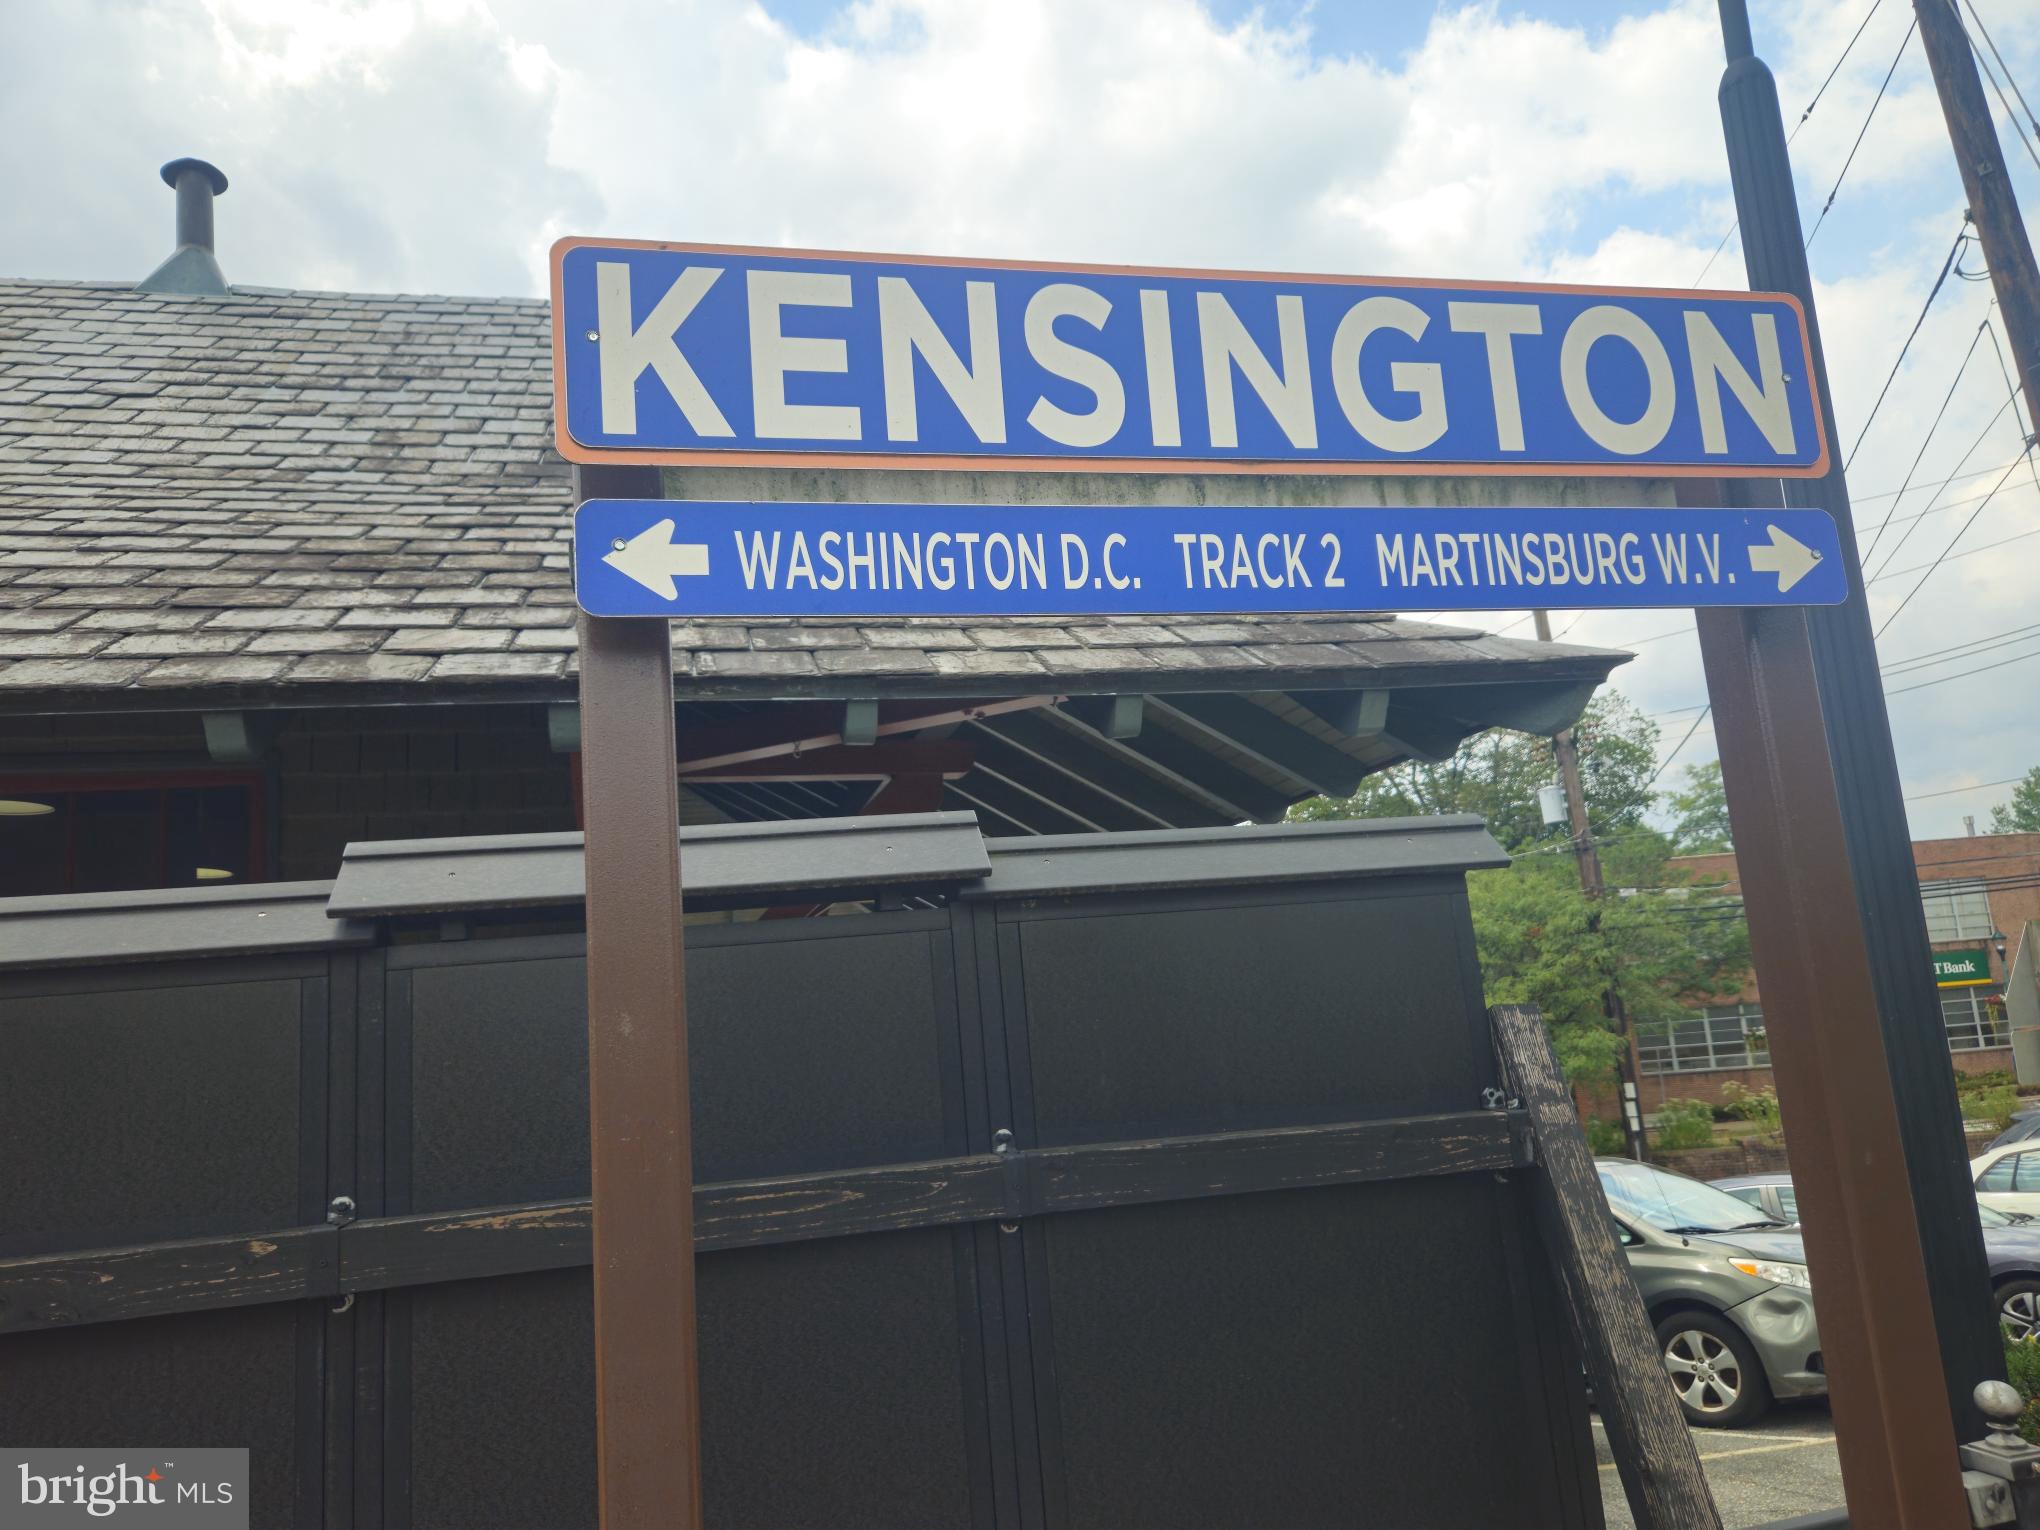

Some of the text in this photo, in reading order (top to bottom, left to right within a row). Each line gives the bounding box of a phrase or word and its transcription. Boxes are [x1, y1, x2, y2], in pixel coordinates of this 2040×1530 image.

[595, 261, 1797, 456] KENSINGTON
[733, 529, 1737, 591] WASHINGTON D.C. TRACK 2 MARTINSBURG W.V.
[1942, 959, 1976, 974] Bank
